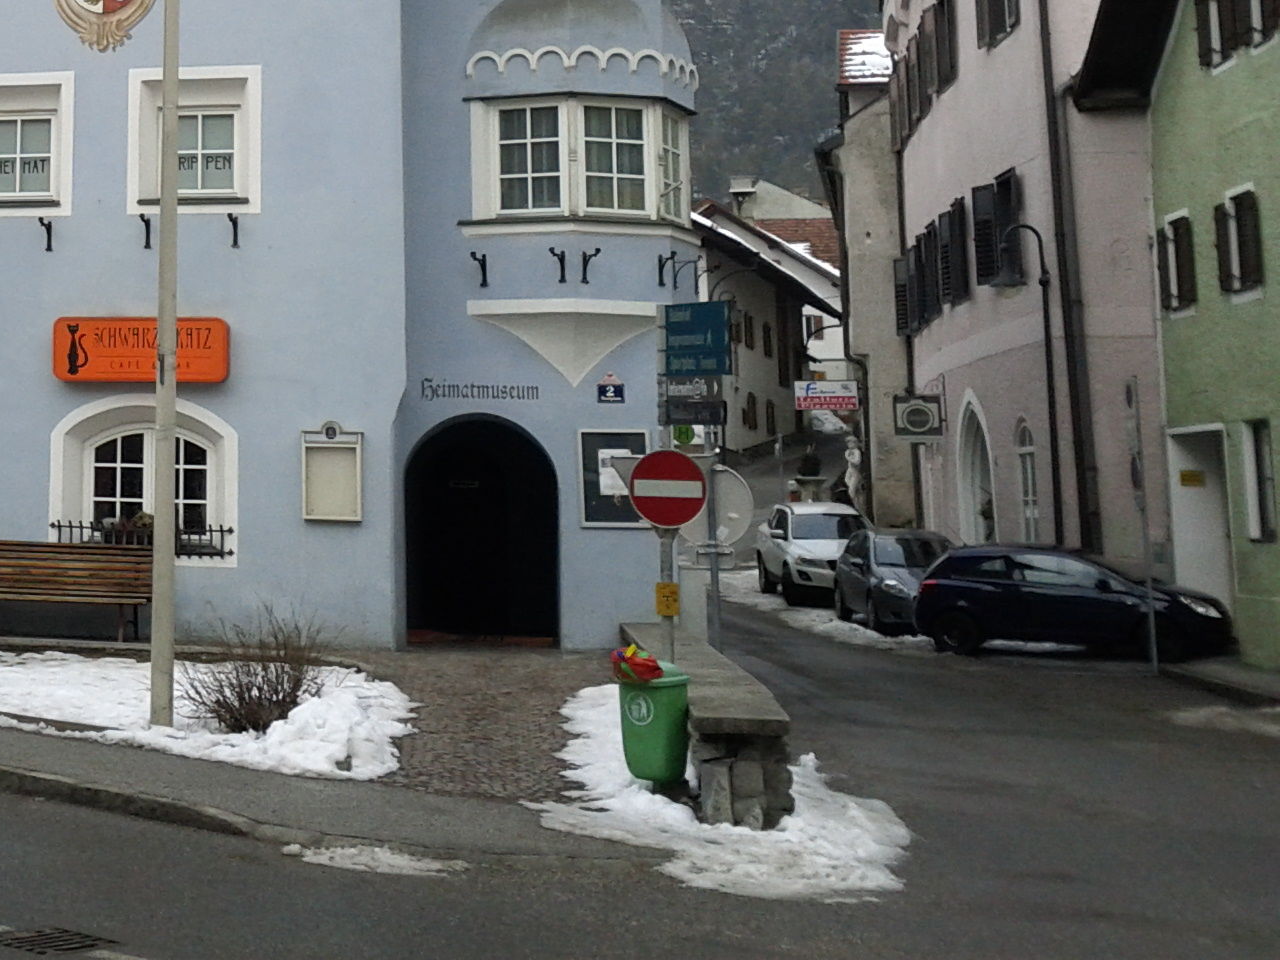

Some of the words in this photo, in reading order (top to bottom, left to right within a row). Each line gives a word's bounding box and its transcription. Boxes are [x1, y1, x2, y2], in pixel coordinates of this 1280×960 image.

[178, 155, 232, 171] RIPPEN
[94, 327, 160, 350] SCHWARZ
[421, 378, 540, 402] Heimatmuseum
[606, 385, 615, 397] 2
[678, 426, 689, 440] H
